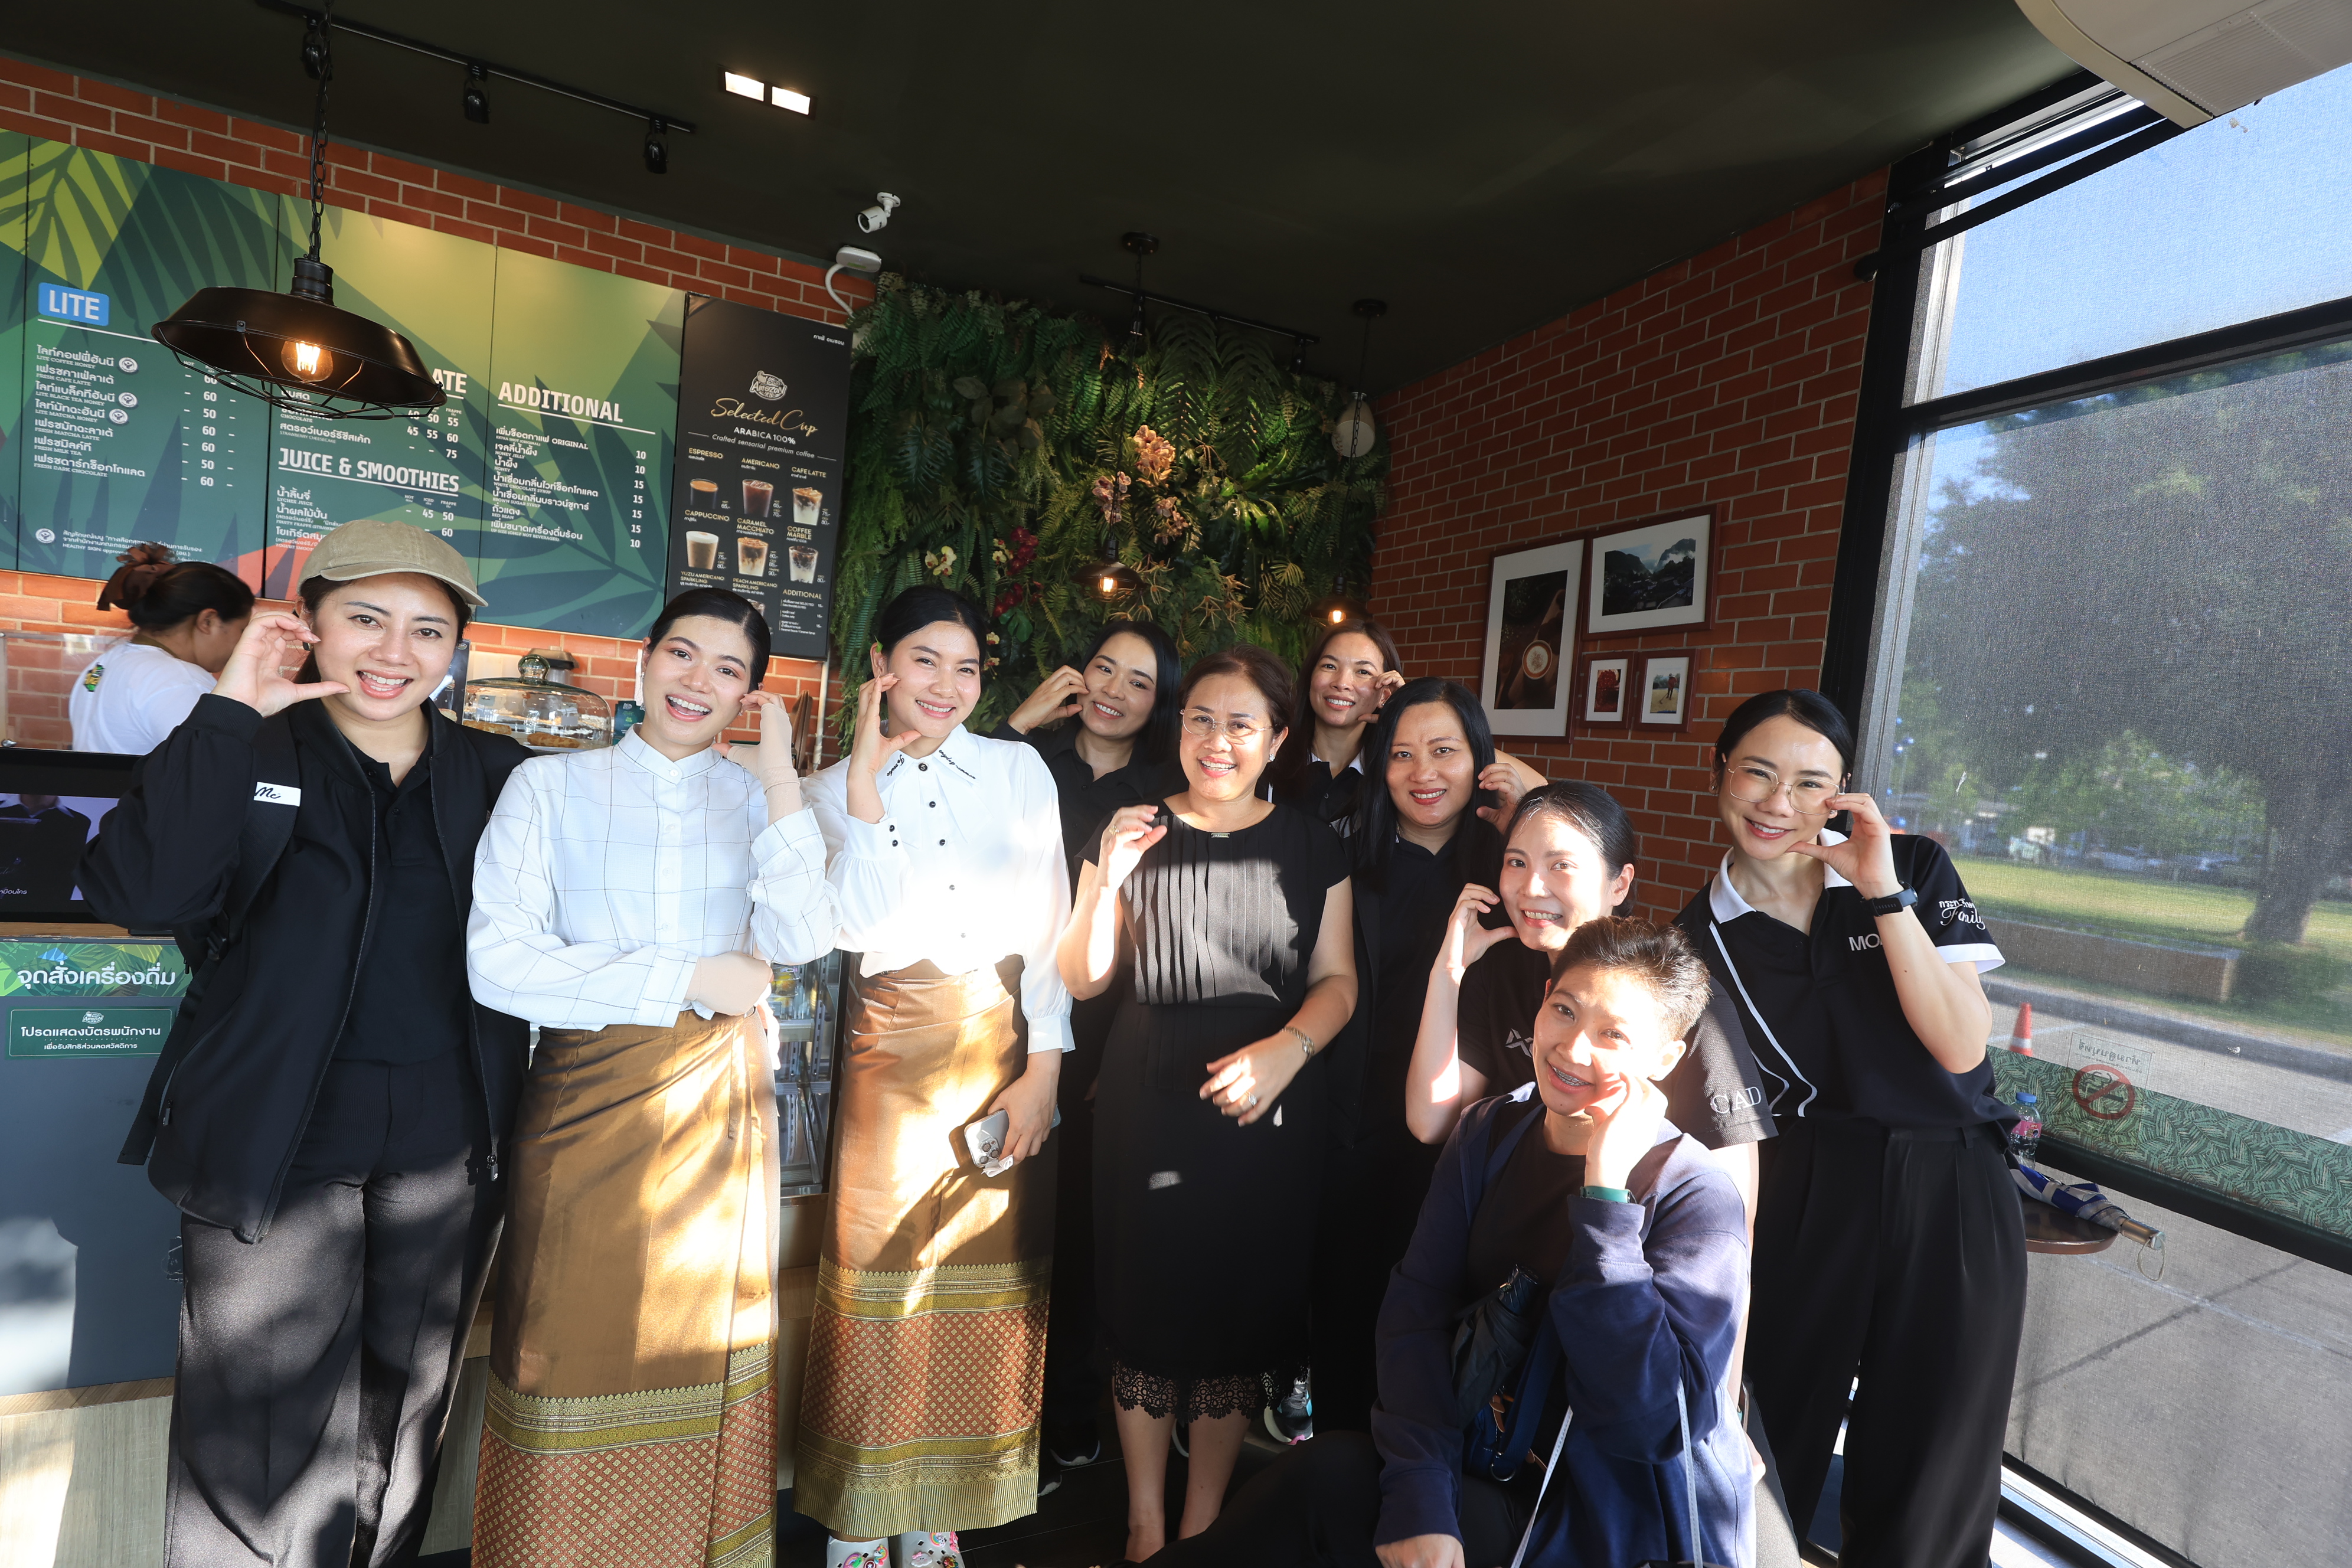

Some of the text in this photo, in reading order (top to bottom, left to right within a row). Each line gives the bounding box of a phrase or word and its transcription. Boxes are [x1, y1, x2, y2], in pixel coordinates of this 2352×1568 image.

[49, 289, 100, 320] LITE
[50, 393, 71, 401] BLACK
[204, 391, 217, 401] 60
[498, 381, 623, 423] ADDITIONAL
[49, 411, 76, 419] MATCHA
[203, 408, 217, 419] 50
[280, 413, 313, 423] CHOCOLATE
[710, 397, 818, 437] Selected Cup
[427, 413, 439, 423] 50
[447, 417, 459, 427] 55
[54, 430, 81, 438] MATCHA
[202, 426, 216, 436] 60
[279, 430, 336, 443] STRAWBERRY CHEESECAKE
[407, 426, 459, 443] 45 55 60
[733, 426, 796, 445] ARABICA 100%
[496, 425, 589, 450] เพิ่มช็อตกาแฟ ORIGINAL
[201, 442, 215, 453] 60
[712, 434, 815, 459] Crafted sensorial premium coffee
[446, 449, 458, 459] 75
[636, 450, 646, 460] 10
[688, 447, 724, 459] ESPRESSO
[201, 459, 215, 470] 50
[495, 455, 518, 469] น้ำผึ้ง
[741, 458, 780, 470] AMERICANO
[71, 468, 109, 477] CHOCOLATE
[278, 447, 460, 492] JUICE & SMOOTHIES
[635, 465, 645, 475] 10
[791, 466, 807, 475] CAFE
[808, 469, 827, 478] LATTE
[200, 476, 214, 486] 60
[633, 479, 644, 489] 15
[509, 484, 537, 492] CHOCOLATE
[632, 494, 643, 504] 15
[492, 502, 520, 515] ถั่วแดง
[632, 509, 642, 519] 15
[422, 509, 454, 521] 45 50
[684, 509, 730, 522] CAPPUCCINO
[737, 518, 767, 528] CARAMEL
[442, 528, 453, 537] 60
[631, 524, 641, 534] 15
[736, 524, 775, 535] MACCHIATO
[787, 525, 812, 534] COFFEE
[786, 531, 812, 541] MARBLE
[630, 539, 641, 548] 10
[782, 589, 822, 600] ADDITIONAL
[1848, 933, 1883, 951] MO
[17, 961, 175, 989] จุดสั่งเครื่องดื่ม
[21, 1026, 161, 1037] โปรดแสดงบัตรพนักงาน
